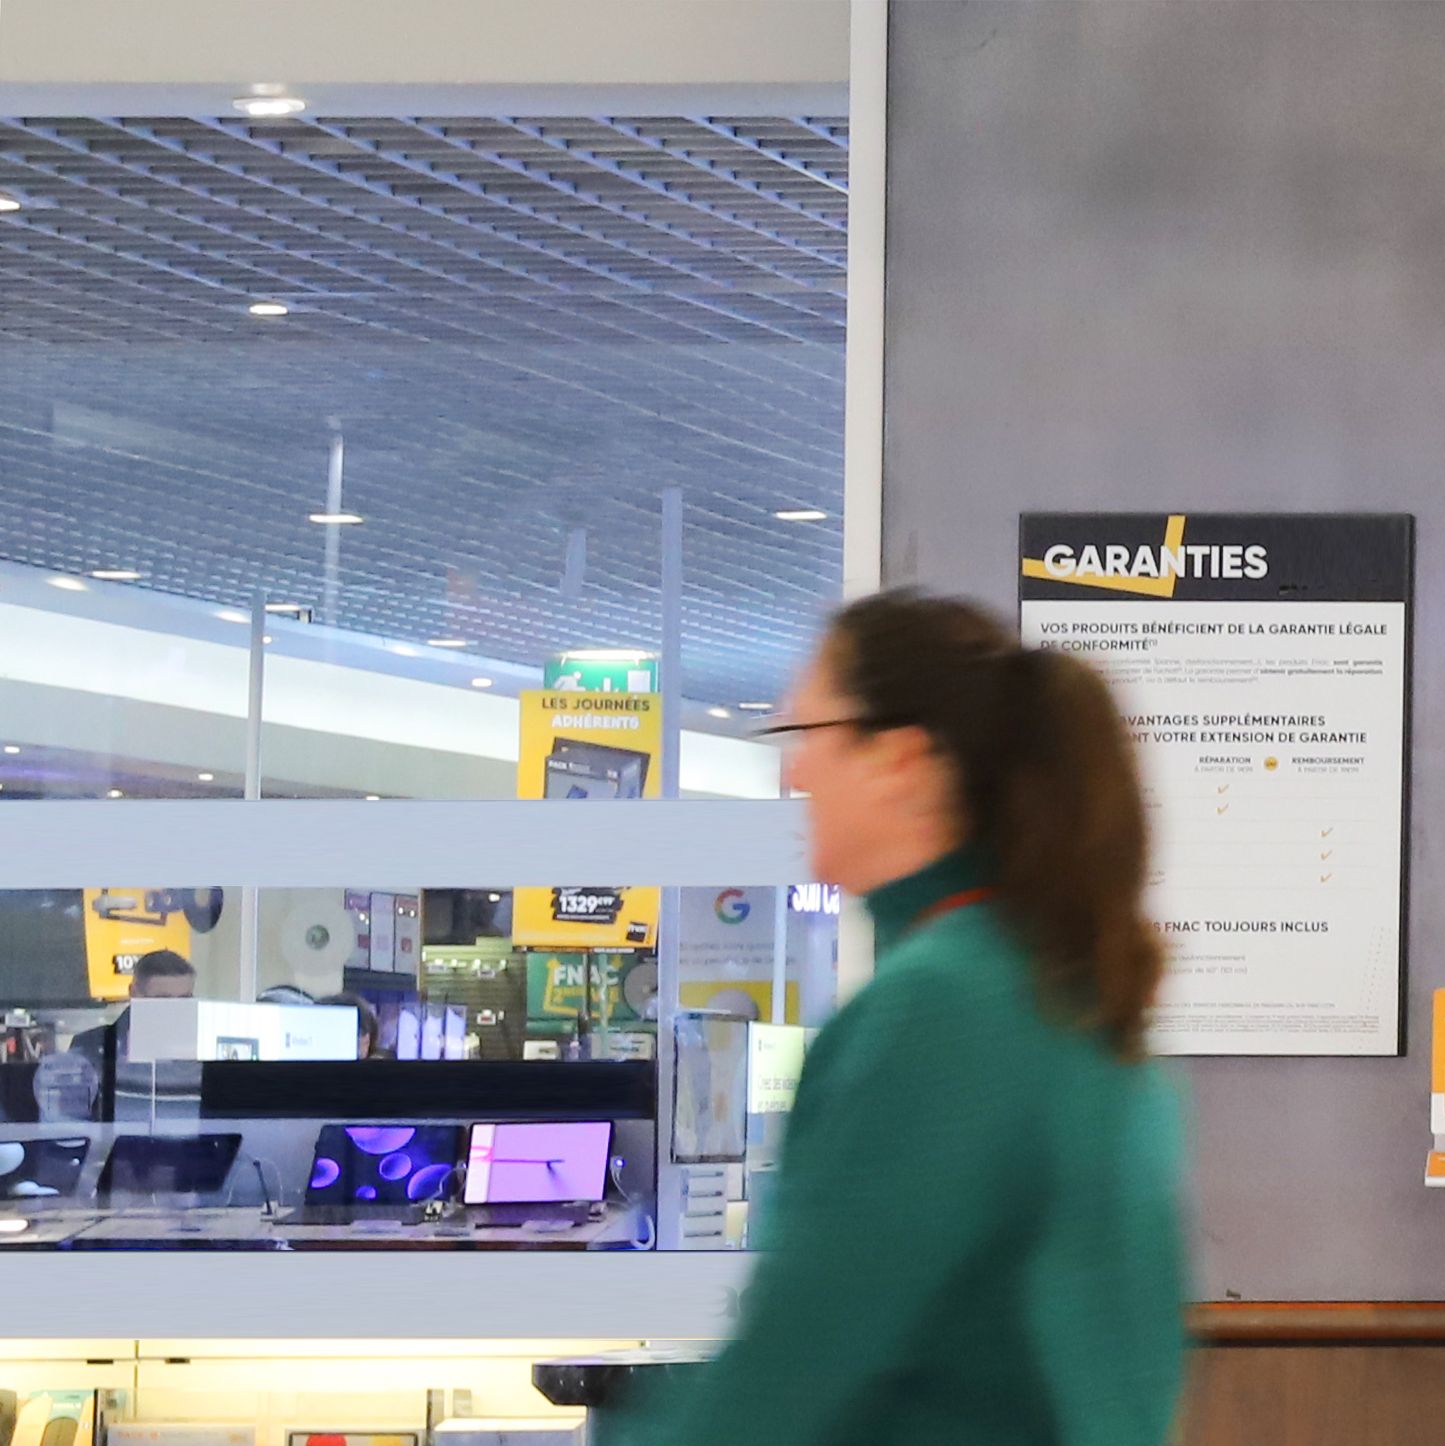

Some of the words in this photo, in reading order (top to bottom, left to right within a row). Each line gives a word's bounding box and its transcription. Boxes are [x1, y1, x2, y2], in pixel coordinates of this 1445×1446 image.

[1043, 544, 1269, 580] GARANTIES
[1040, 623, 1069, 635] VOS
[1072, 623, 1139, 635] PRODUITS
[1142, 620, 1224, 635] BÉNÉFICIENT
[1227, 623, 1246, 635] DE
[1248, 623, 1266, 635] LA
[1268, 623, 1336, 636] GARANTIE
[1339, 621, 1388, 636] LÉGALE
[541, 697, 568, 710] LES
[572, 695, 651, 712] JOURNÉES
[551, 713, 640, 730] ADHÉRENTS
[1202, 712, 1326, 726] SUPPLÉMENTAIRES
[1153, 731, 1198, 743] VOTRE
[1200, 731, 1275, 744] EXTENSION
[1277, 731, 1296, 744] DE
[1298, 731, 1368, 744] GARANTIE
[1199, 755, 1252, 764] RÉPARATION
[1291, 756, 1365, 764] REMBOURSEMENT
[1164, 920, 1201, 933] FNAC
[1204, 921, 1278, 933] TOUJOURS
[1280, 921, 1329, 933] INCLUS
[553, 963, 620, 987] FNAC
